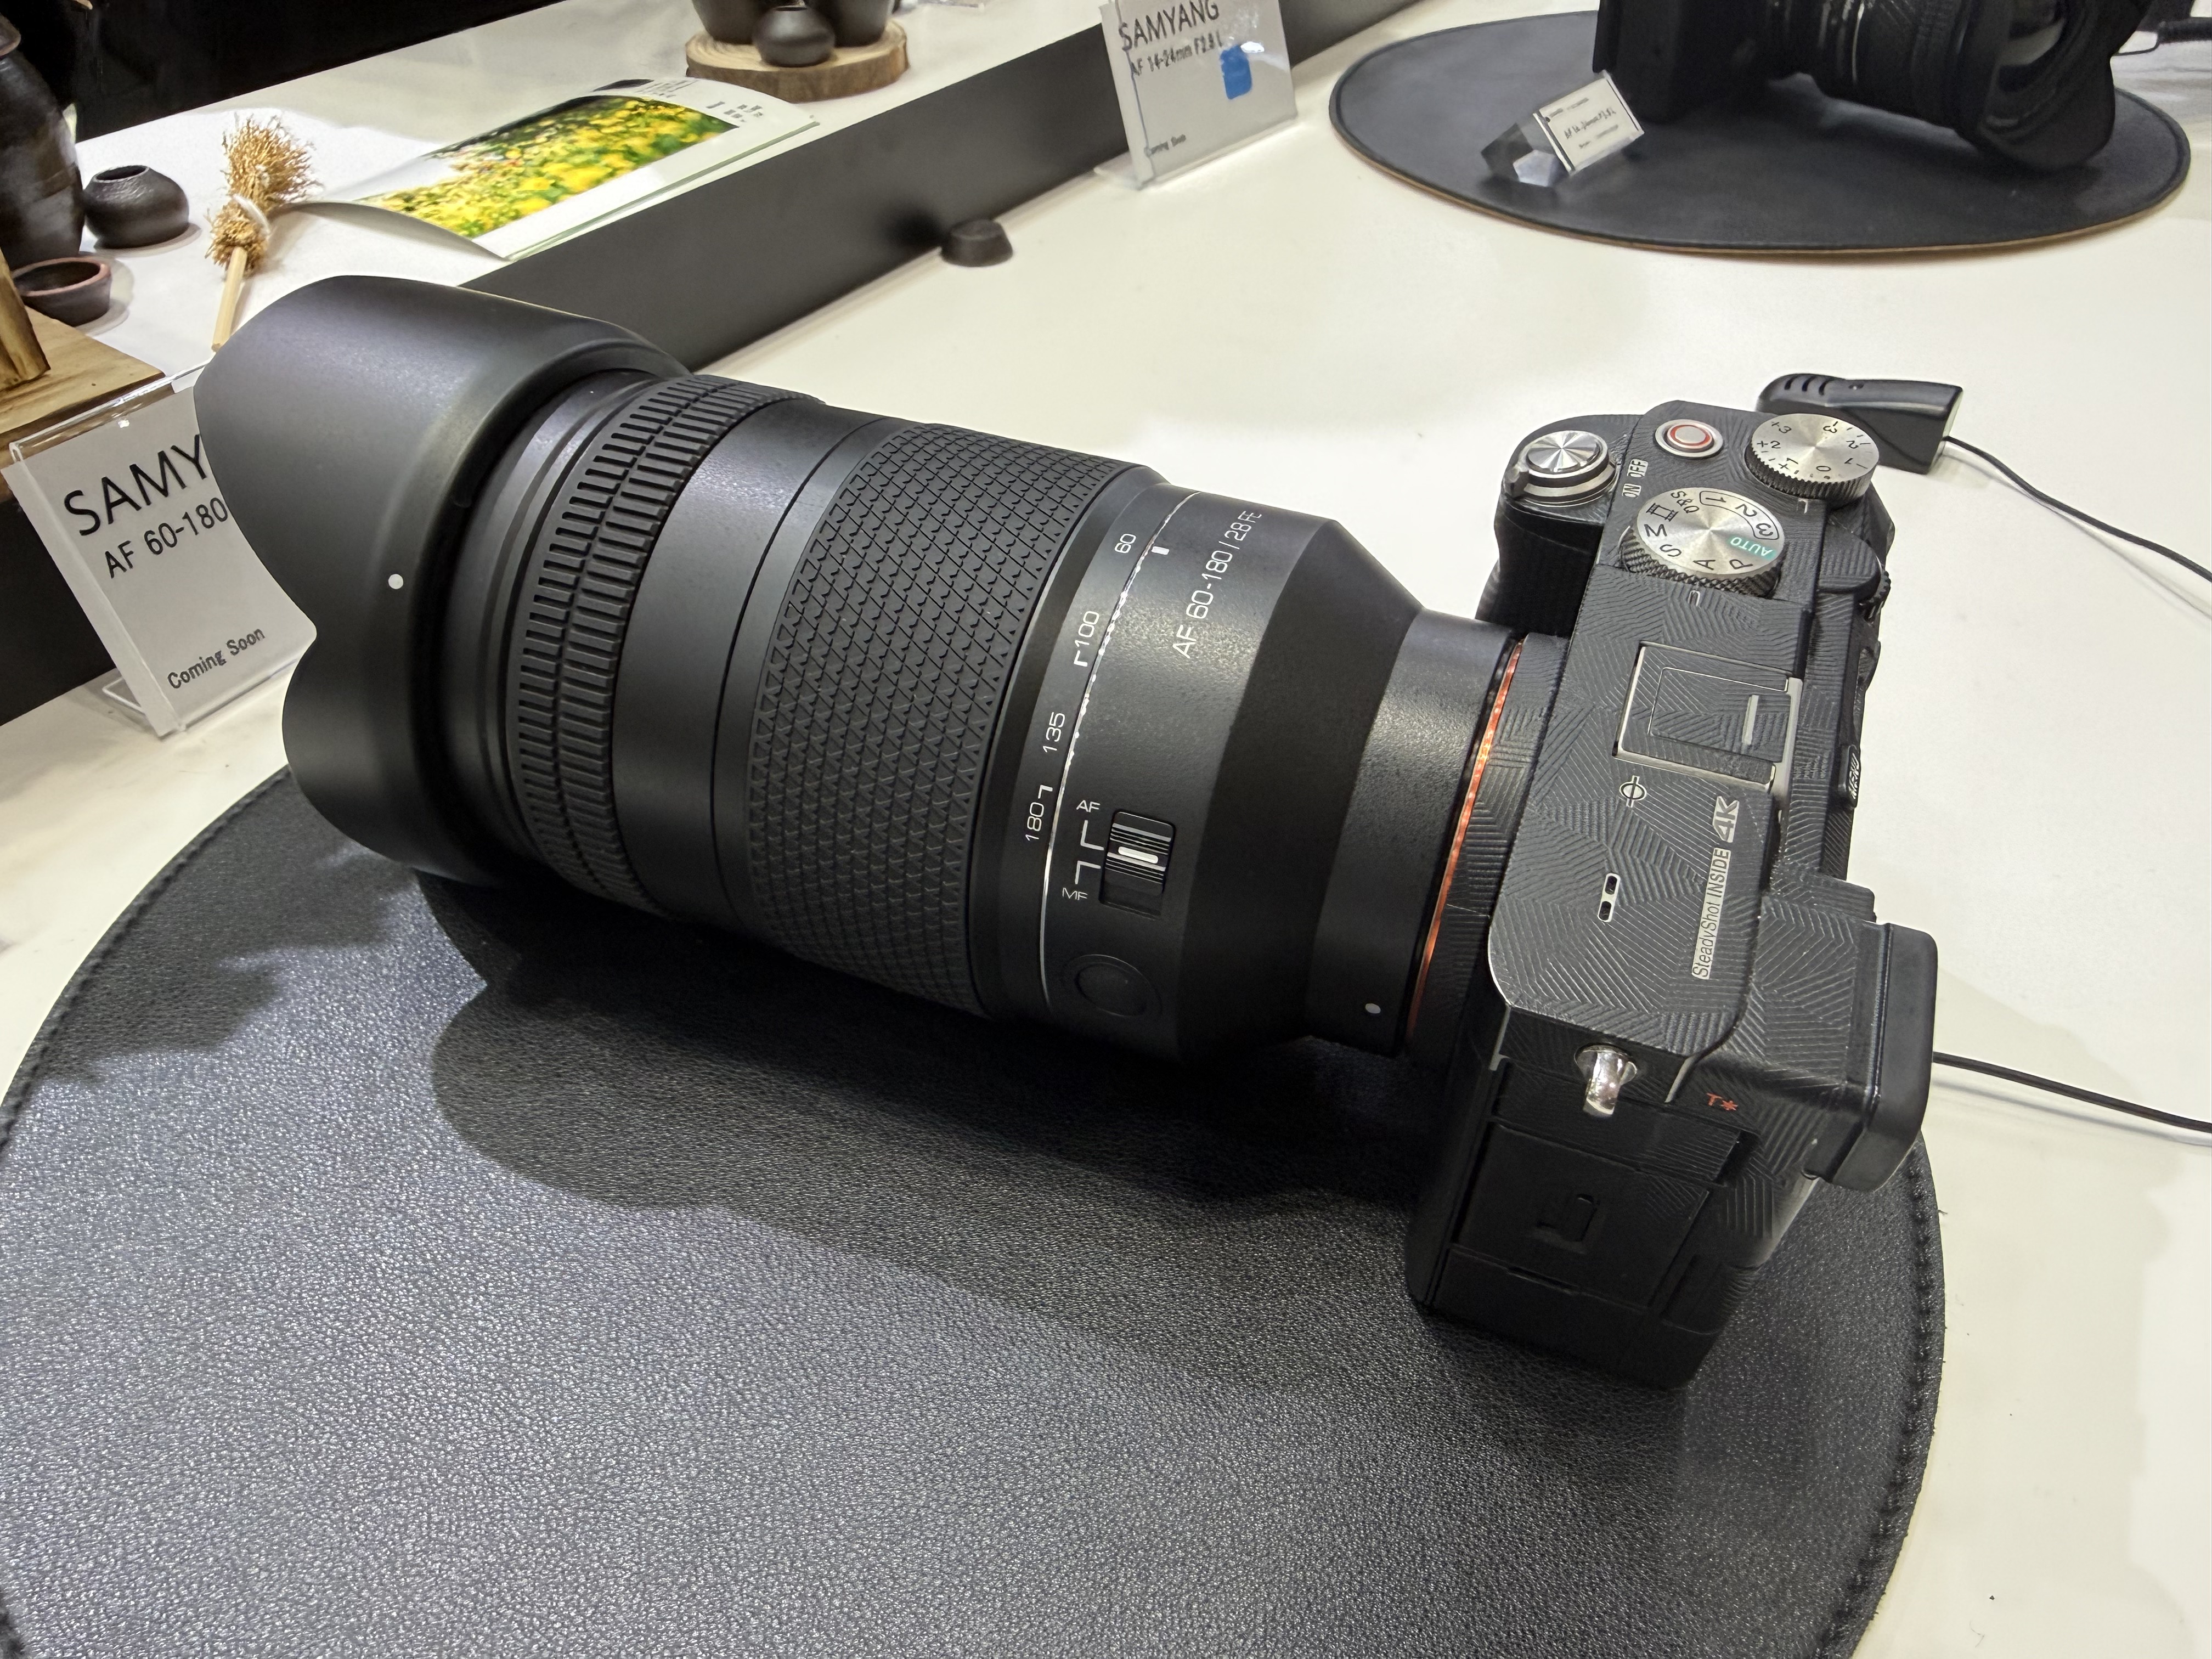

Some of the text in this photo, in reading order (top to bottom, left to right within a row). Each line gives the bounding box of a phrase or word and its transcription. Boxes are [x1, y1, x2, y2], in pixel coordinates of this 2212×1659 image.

[1119, 0, 1220, 51] SAMYANG
[1757, 441, 1781, 449] +2
[1628, 460, 1646, 478] OFF
[1623, 484, 1640, 498] ON
[1671, 491, 1700, 514] S&Q
[1735, 504, 1758, 517] 2
[1644, 523, 1667, 537] M
[1756, 523, 1774, 537] 3
[1115, 533, 1136, 553] 60
[1659, 544, 1681, 557] S
[1730, 537, 1773, 557] AUTO
[105, 540, 134, 578] AF
[1693, 559, 1716, 571] A
[1729, 559, 1753, 569] P
[1075, 611, 1099, 648] 100
[1172, 624, 1197, 659] AF
[167, 628, 266, 689] Coming Soon
[1043, 712, 1065, 753] 135
[1076, 800, 1101, 813] AF
[1025, 802, 1044, 840] 180
[1713, 796, 1739, 843] 4K
[1062, 887, 1088, 900] MF
[1692, 849, 1729, 978] SteadyShot INSIDE
